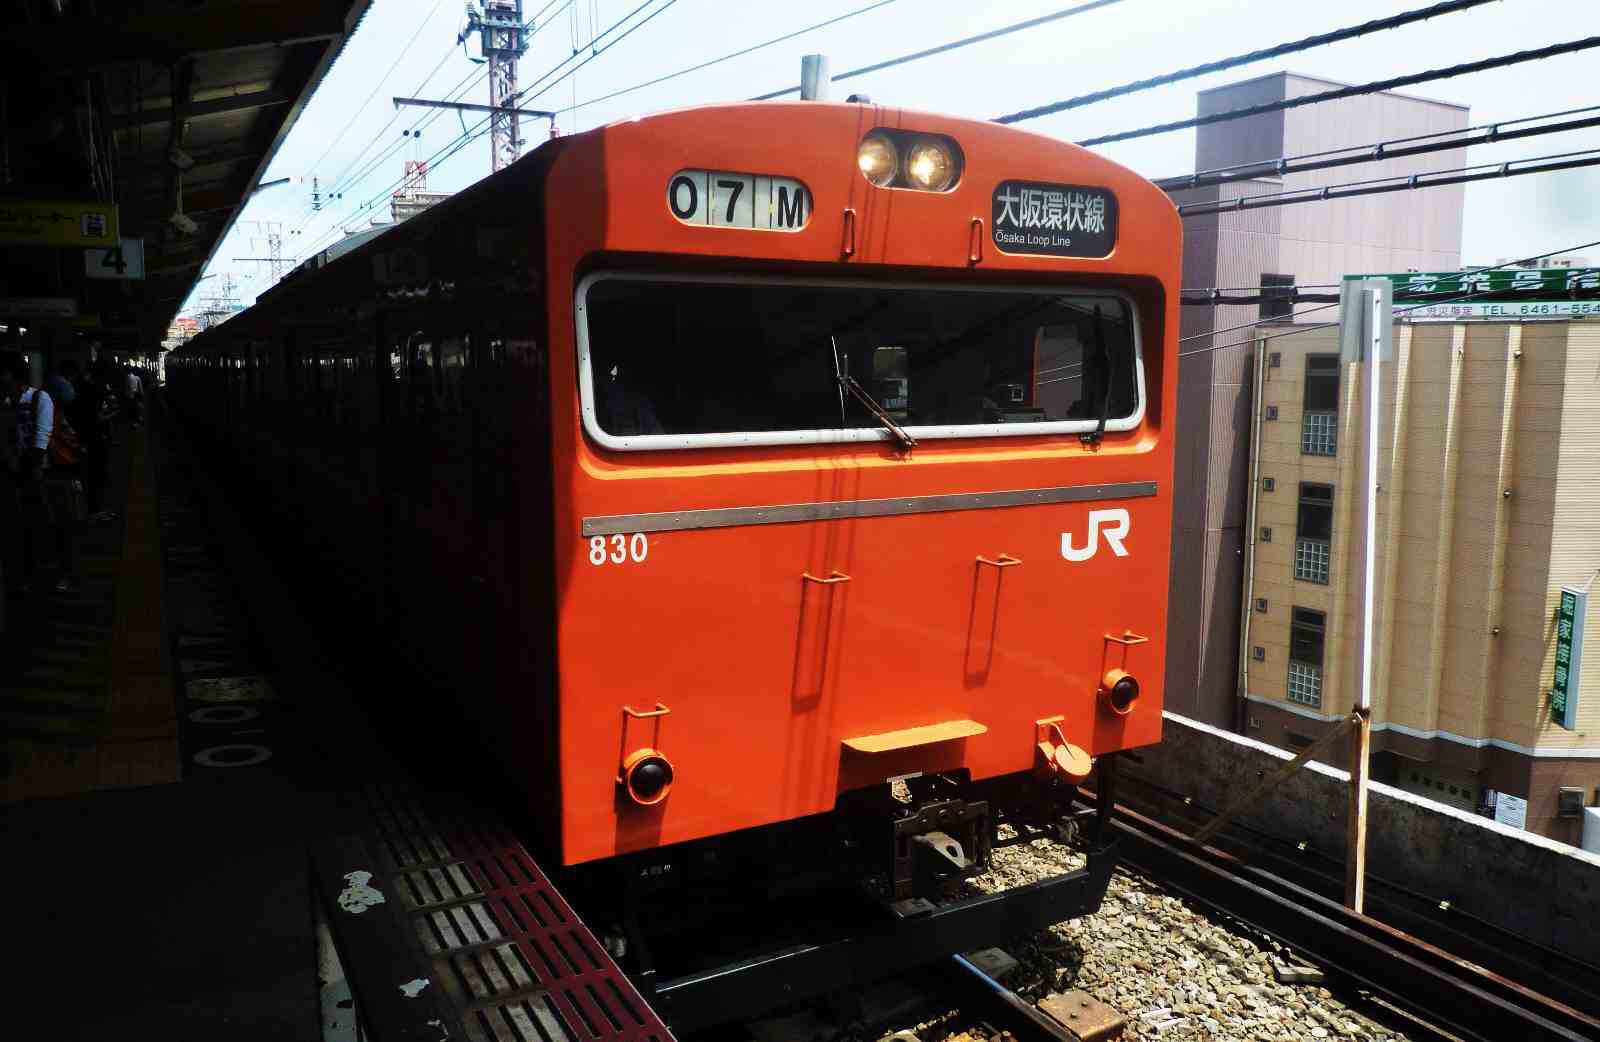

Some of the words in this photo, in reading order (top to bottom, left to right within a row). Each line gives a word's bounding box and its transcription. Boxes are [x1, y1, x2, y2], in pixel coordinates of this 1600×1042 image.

[996, 186, 1105, 233] 大阪環状線
[1027, 233, 1050, 247] Loop
[1052, 234, 1071, 247] Line
[102, 246, 127, 274] 4
[589, 532, 648, 566] 830
[1061, 508, 1130, 562] JR
